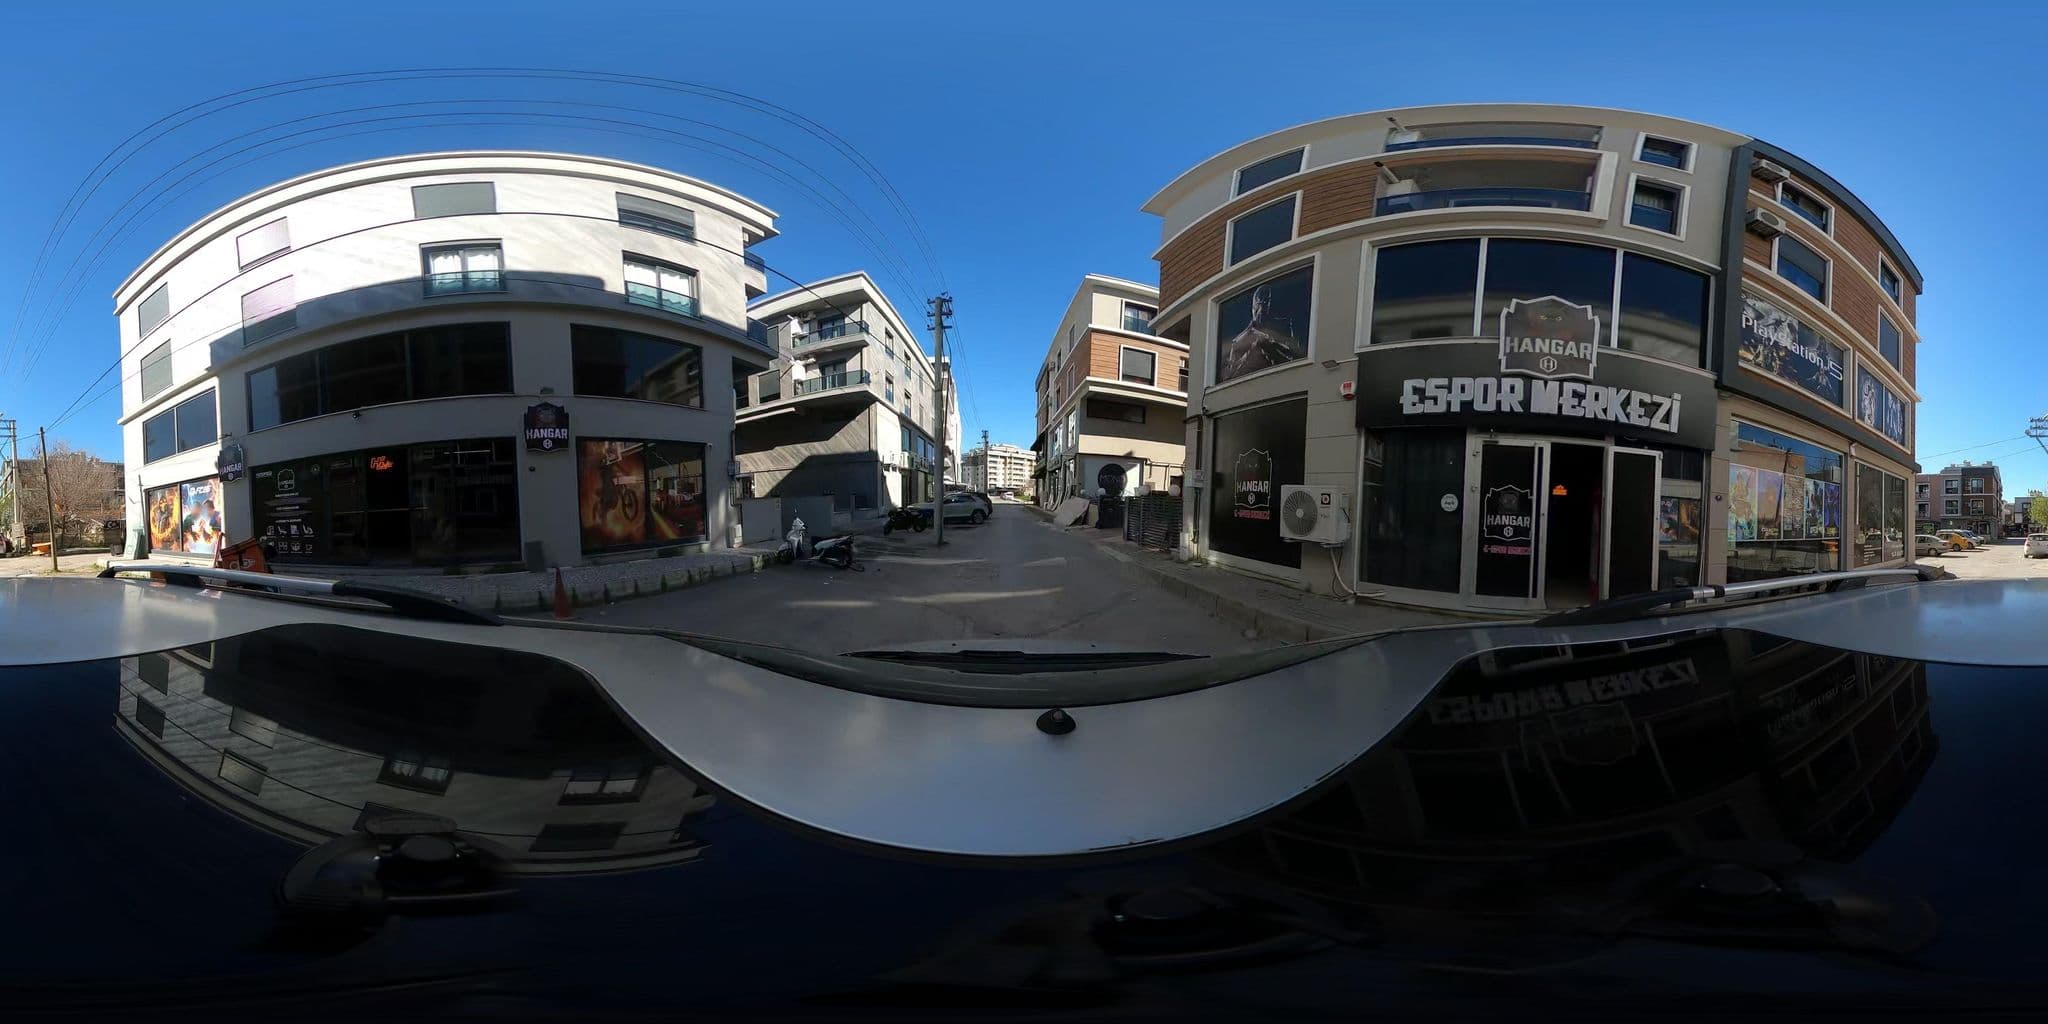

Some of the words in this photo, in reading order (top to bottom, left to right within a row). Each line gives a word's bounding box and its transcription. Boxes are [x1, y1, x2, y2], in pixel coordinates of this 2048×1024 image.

[1505, 336, 1593, 360] HANGAR
[1400, 377, 1524, 414] ESPOR
[1531, 379, 1683, 434] MERKEZİ
[526, 428, 568, 439] HANGAR
[220, 463, 242, 475] HANGAR
[1236, 480, 1269, 493] HANGAR
[1487, 514, 1530, 528] HANGAR
